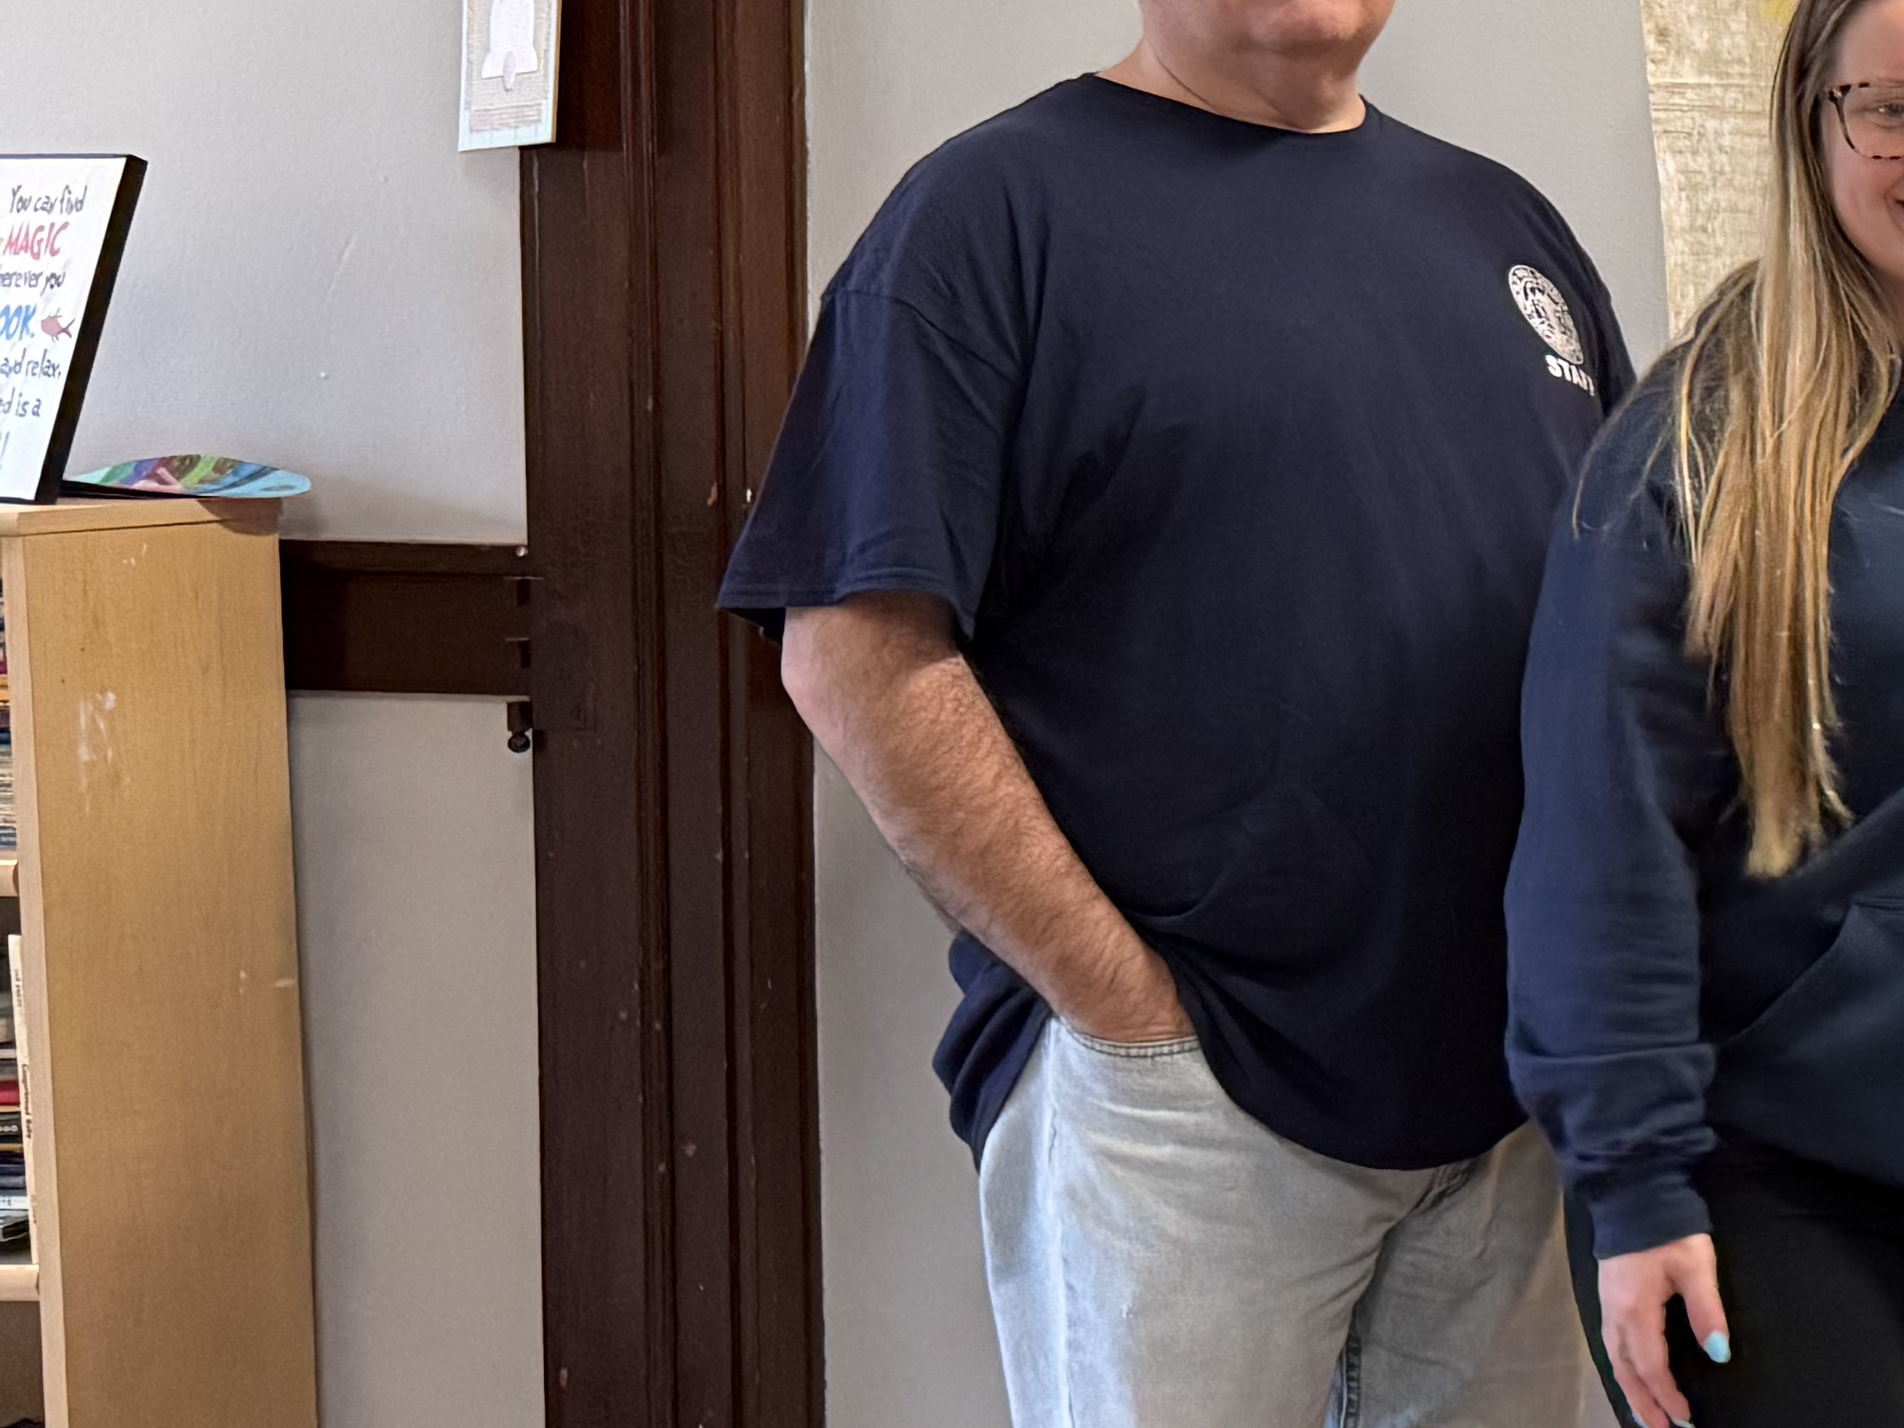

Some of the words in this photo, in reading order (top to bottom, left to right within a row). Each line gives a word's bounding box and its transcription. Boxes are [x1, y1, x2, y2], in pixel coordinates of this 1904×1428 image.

[10, 184, 32, 213] You
[3, 220, 70, 261] MAGIC
[0, 304, 36, 341] OOK.
